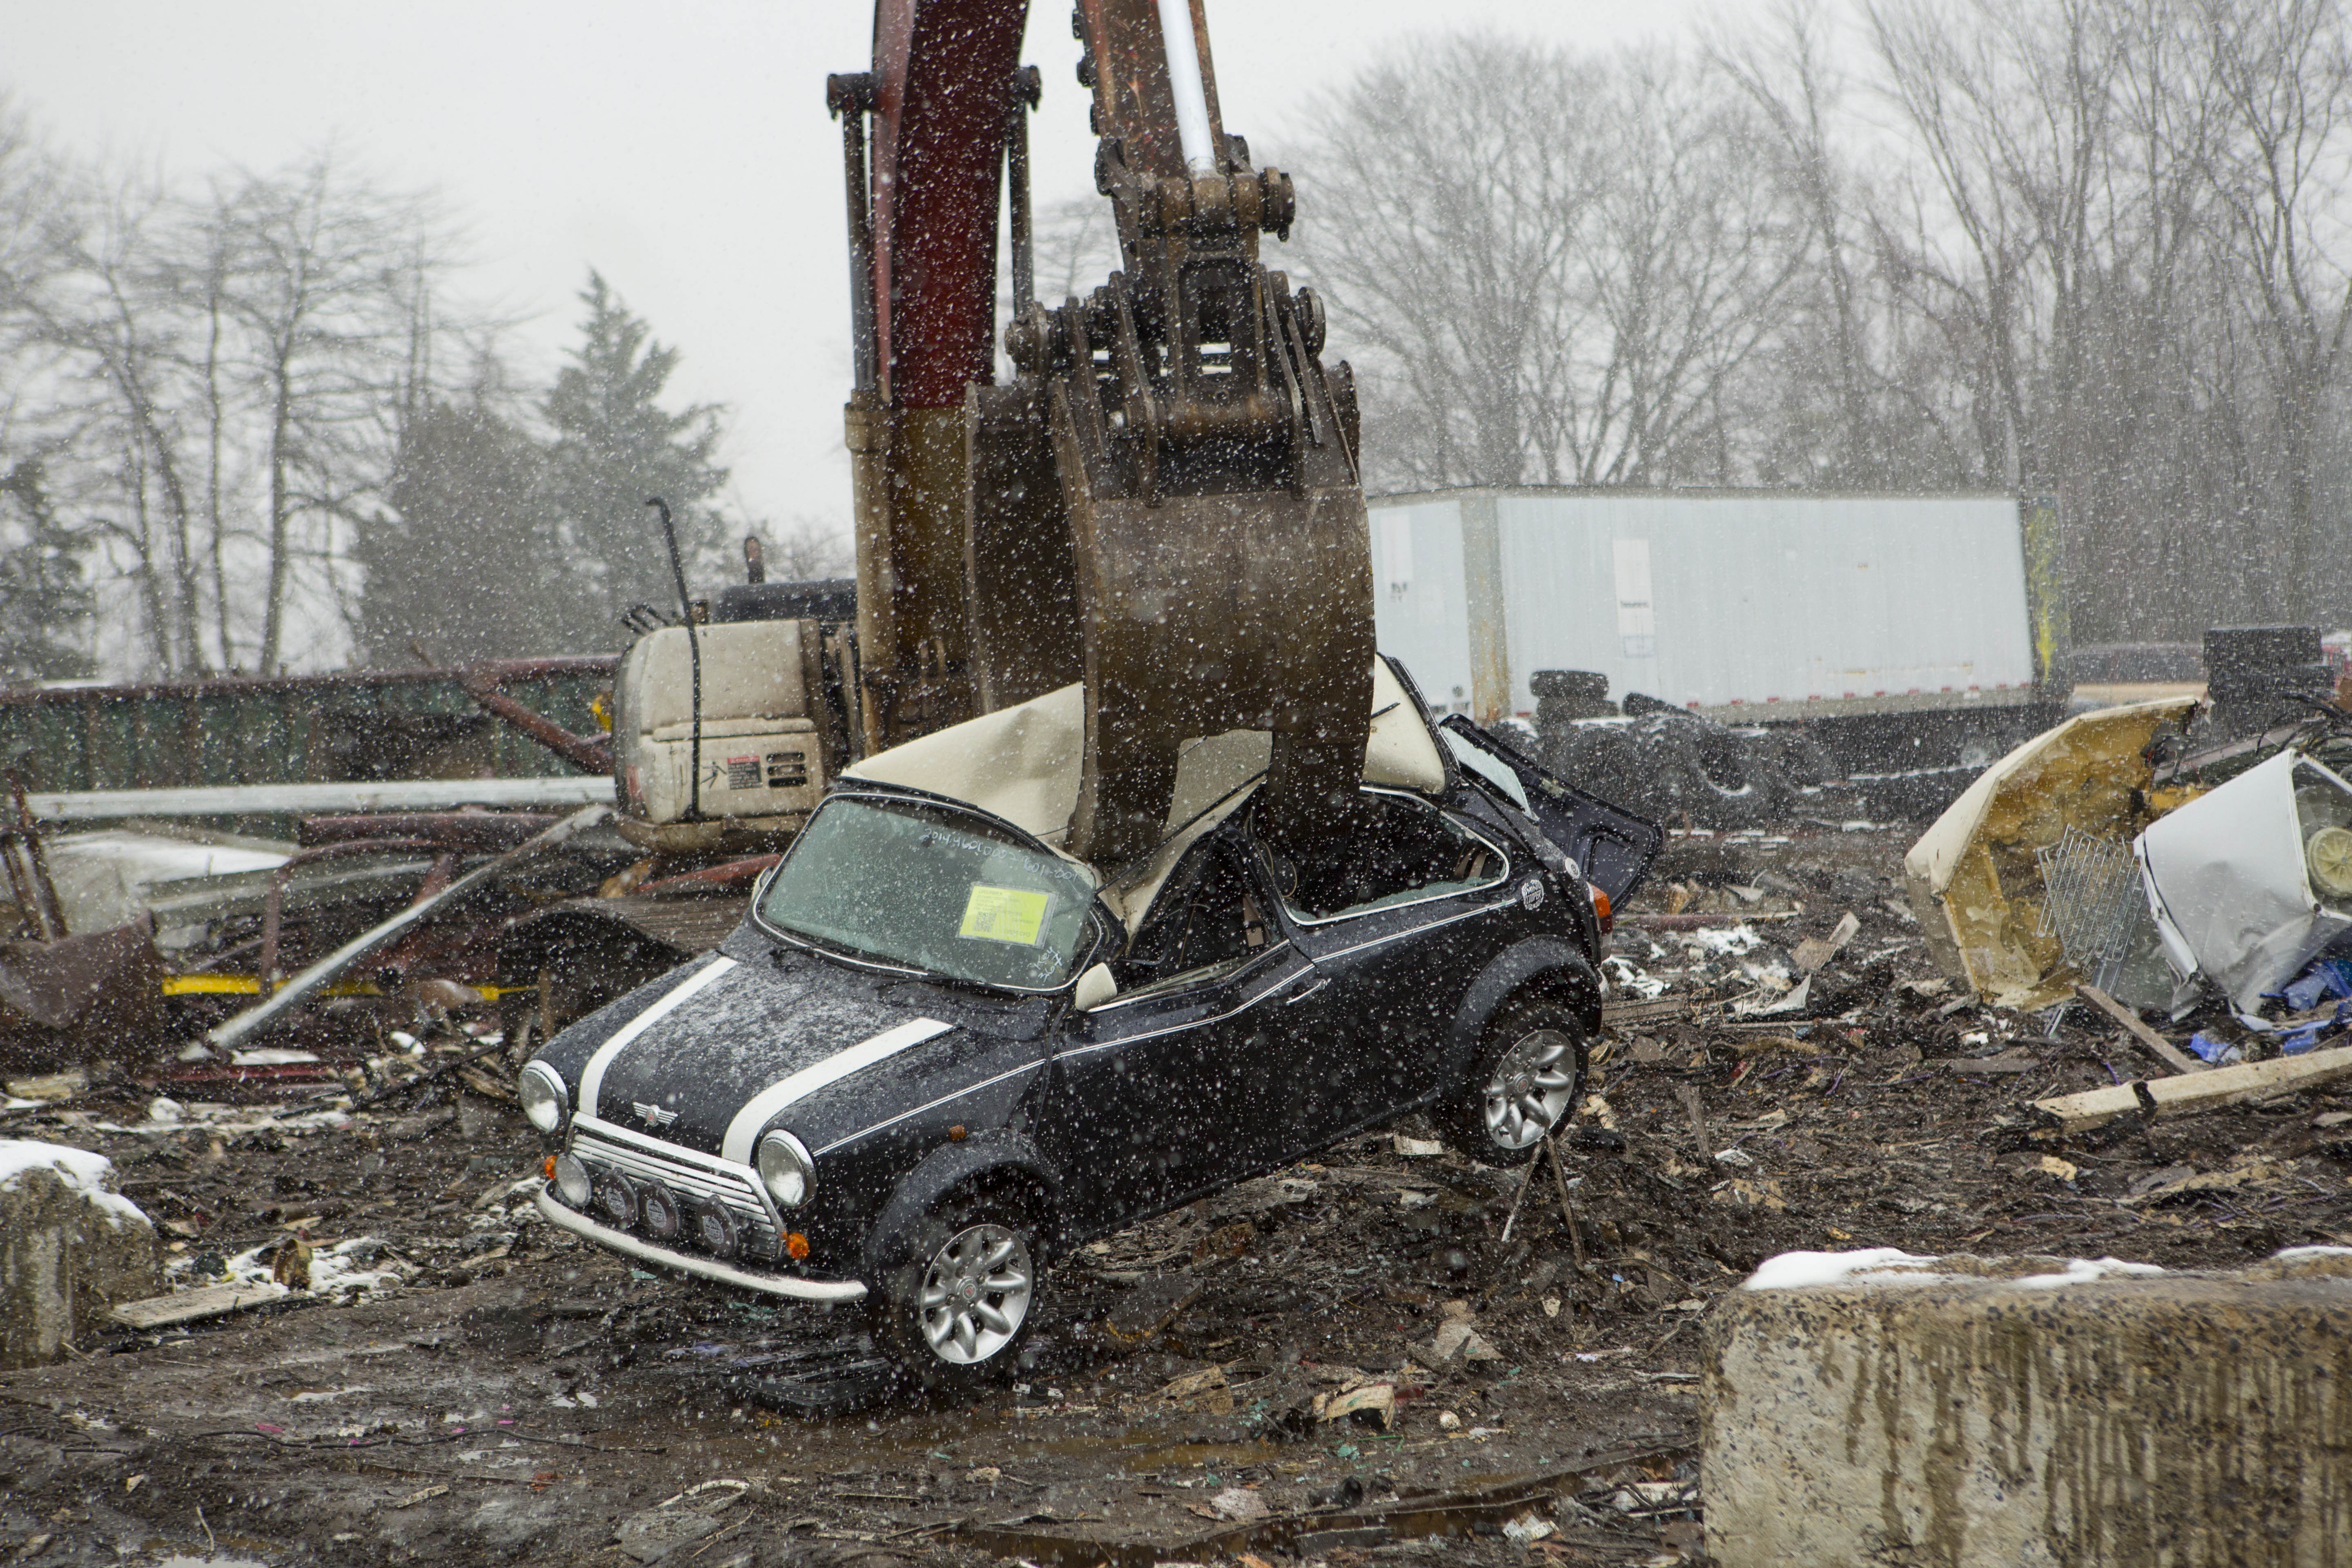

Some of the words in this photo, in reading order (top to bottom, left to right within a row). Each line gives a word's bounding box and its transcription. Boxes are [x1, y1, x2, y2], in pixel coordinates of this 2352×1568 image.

[1526, 884, 1539, 895] MINI
[1526, 890, 1541, 904] COOPER
[1033, 946, 1056, 970] Key
